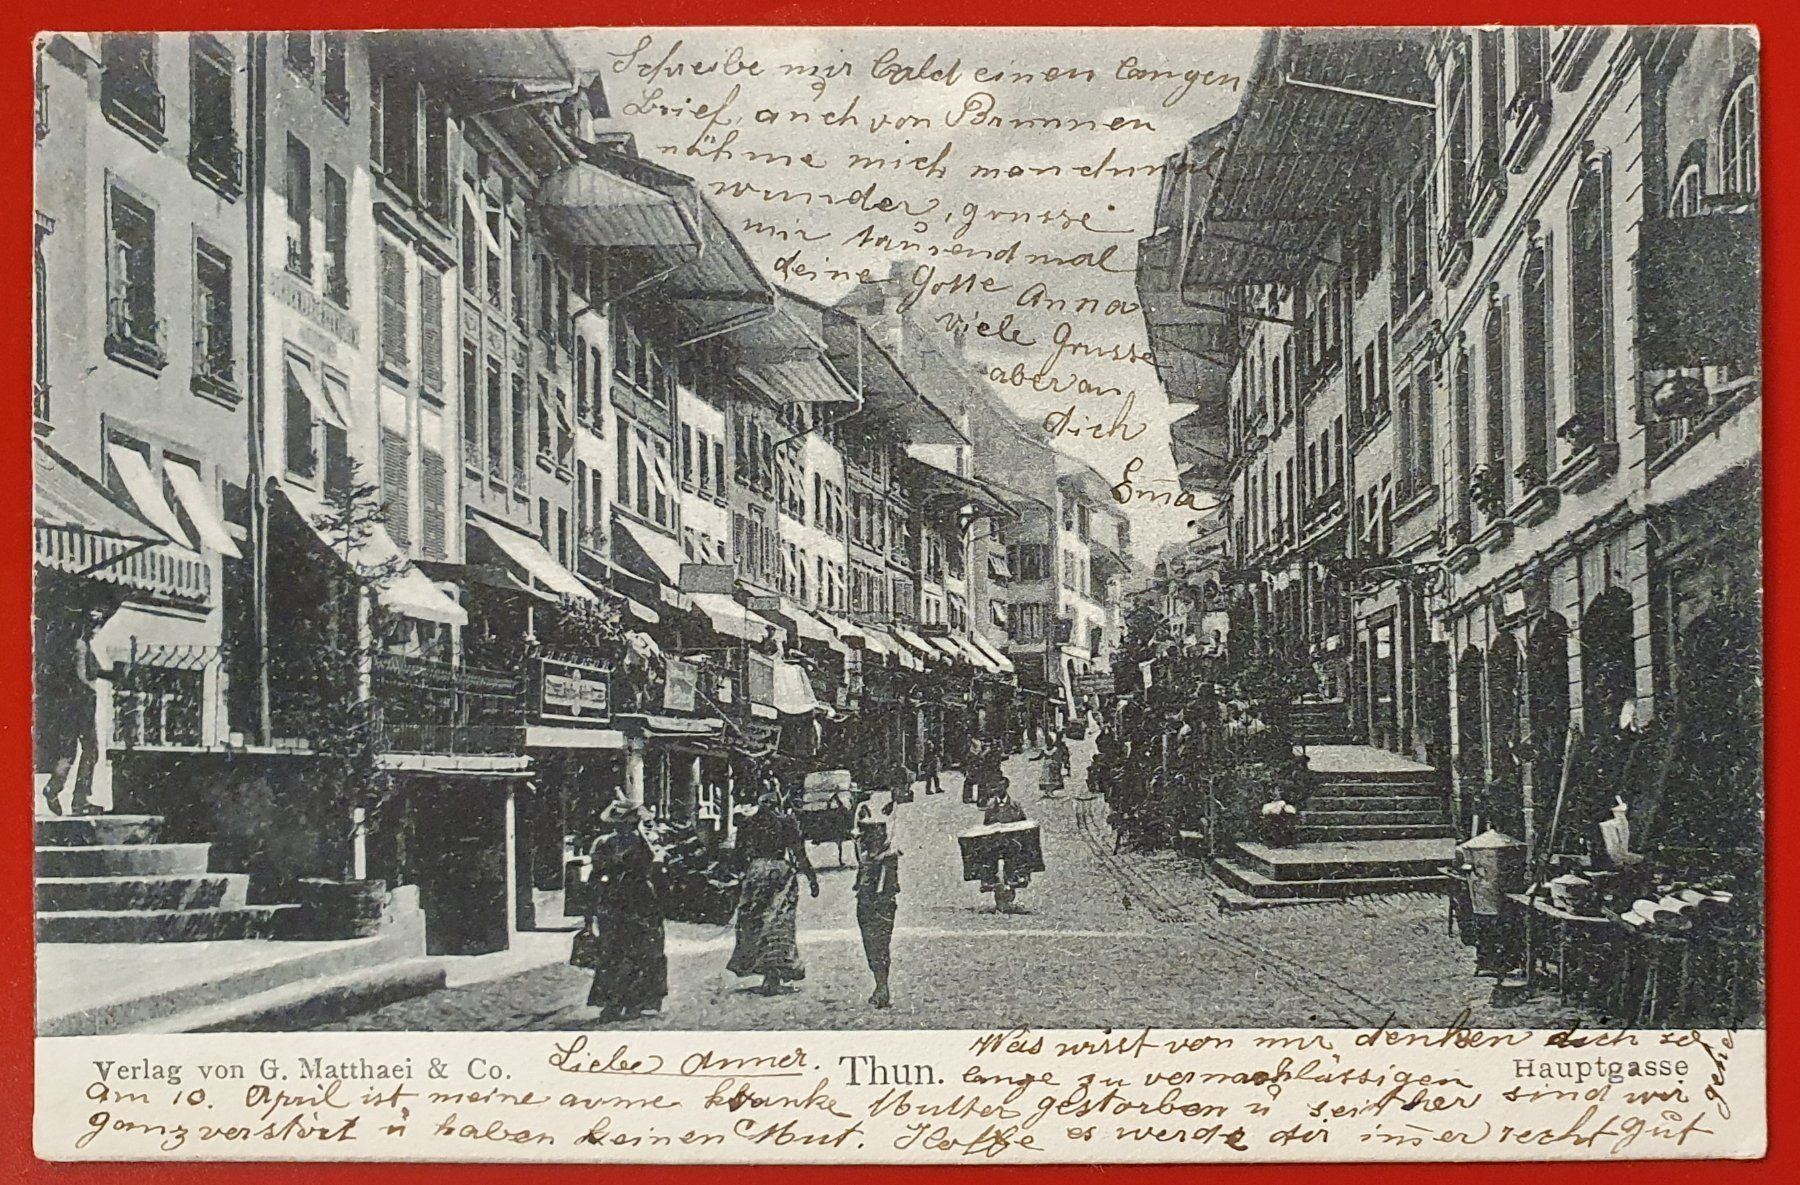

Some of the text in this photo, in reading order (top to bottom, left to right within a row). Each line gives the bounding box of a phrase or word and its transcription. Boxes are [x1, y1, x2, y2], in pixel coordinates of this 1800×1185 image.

[607, 34, 1242, 107] Schreibe mir bald einen langen
[754, 82, 858, 126] auch
[868, 114, 931, 134] von
[945, 92, 1156, 133] Brunnen
[849, 139, 953, 179] mich
[743, 218, 831, 242] mir
[774, 250, 900, 284] deine
[970, 1026, 1043, 1057] Was
[1170, 1034, 1233, 1054] von
[1354, 1008, 1533, 1049] denken
[94, 1058, 511, 1084] Verlag von G. Matthaei & Co.
[549, 1035, 664, 1074] Liebe
[839, 1055, 945, 1086] Thun.
[1513, 1058, 1690, 1084] Hauptgasse
[86, 1082, 150, 1104] Am
[172, 1089, 213, 1109] 10.
[246, 1080, 350, 1121] April
[362, 1083, 420, 1108] ist
[428, 1087, 551, 1107] meine
[559, 1091, 683, 1109] arme
[1022, 1088, 1228, 1130] gestorben
[1503, 1081, 1612, 1103] sind
[1622, 1078, 1690, 1105] wir
[962, 1065, 1062, 1105] lange
[433, 1112, 554, 1145] haben
[574, 1116, 726, 1147] keinen
[1066, 1125, 1096, 1142] es
[1268, 1118, 1330, 1144] dir
